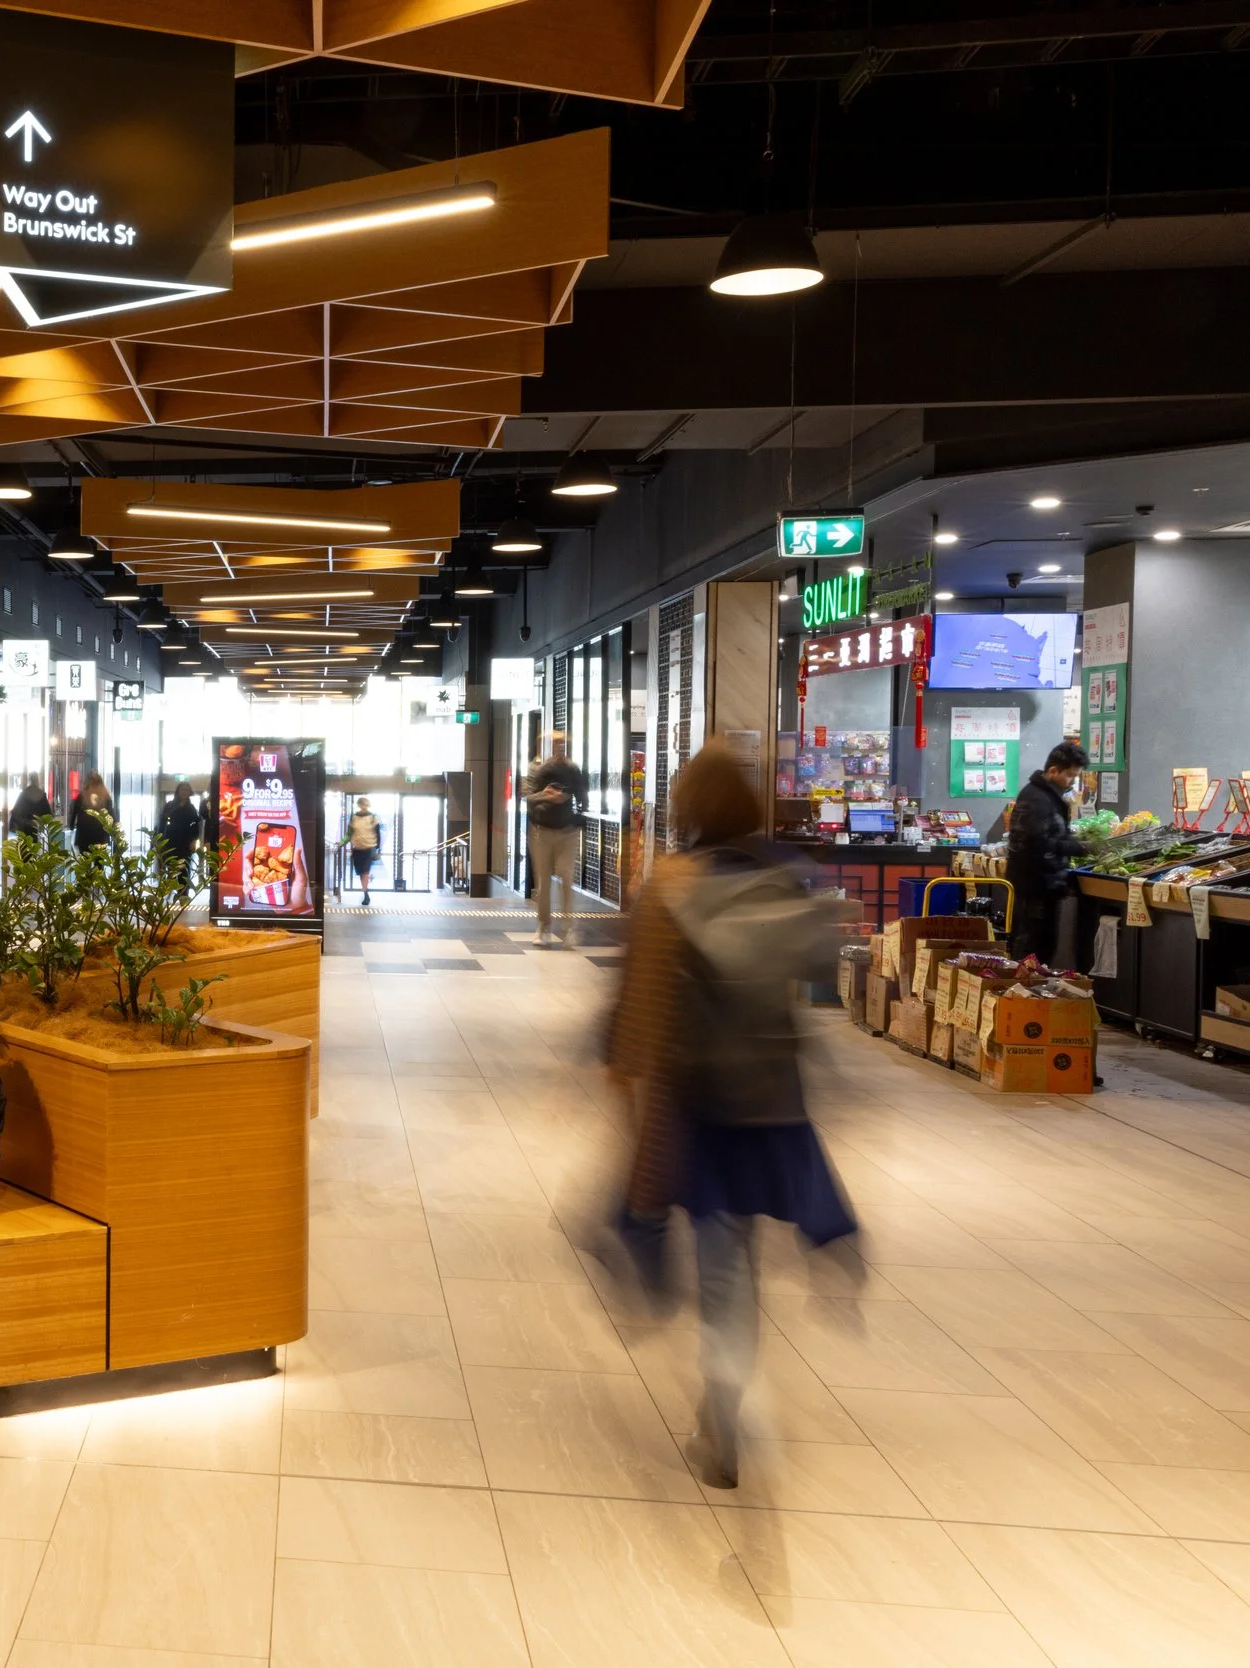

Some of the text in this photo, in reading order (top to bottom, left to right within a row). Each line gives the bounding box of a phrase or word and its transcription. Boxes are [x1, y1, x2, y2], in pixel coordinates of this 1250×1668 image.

[2, 183, 98, 214] Way Out
[3, 211, 137, 246] Brunswick St
[803, 572, 865, 628] SUNLIT
[242, 778, 255, 799] 9
[254, 788, 271, 799] FOR
